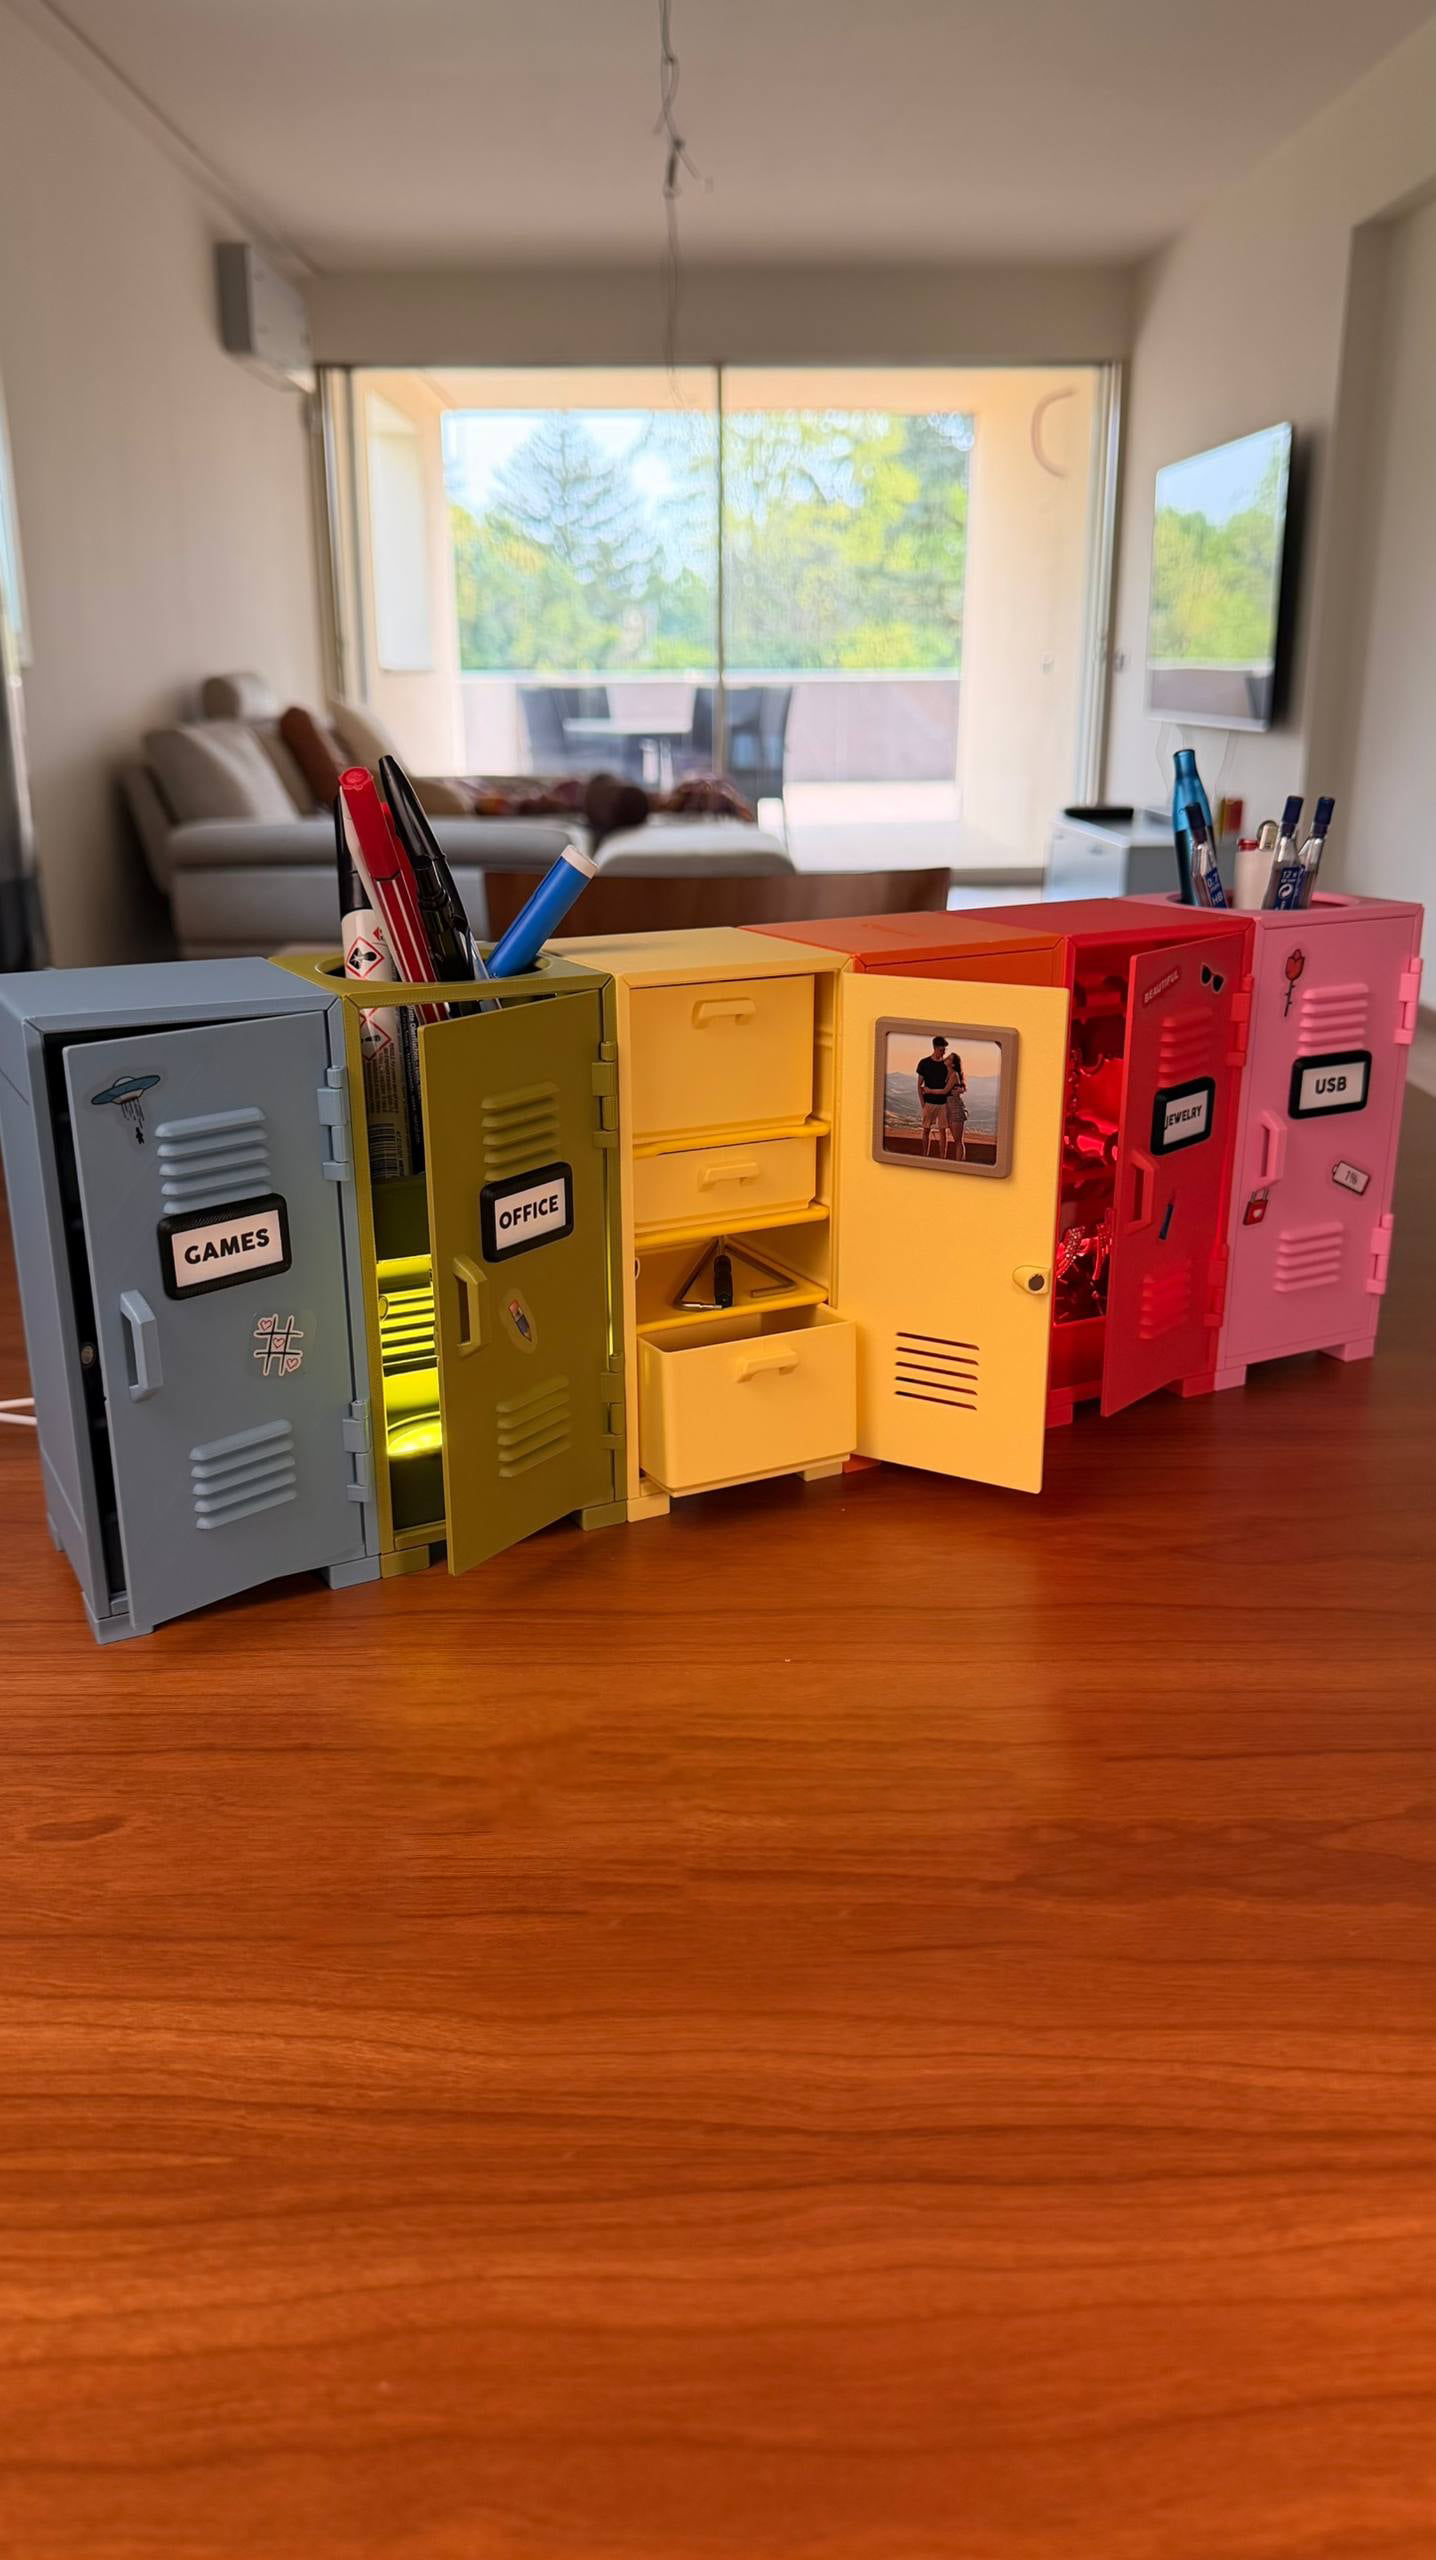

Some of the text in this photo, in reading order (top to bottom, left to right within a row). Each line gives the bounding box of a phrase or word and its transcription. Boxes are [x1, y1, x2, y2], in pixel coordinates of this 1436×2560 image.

[1143, 969, 1180, 1004] BEAUTIFUL
[1314, 1076, 1348, 1095] USB
[1164, 1104, 1202, 1130] JEWELRY
[499, 1194, 559, 1230] OFFICE
[184, 1228, 270, 1265] GAMES
